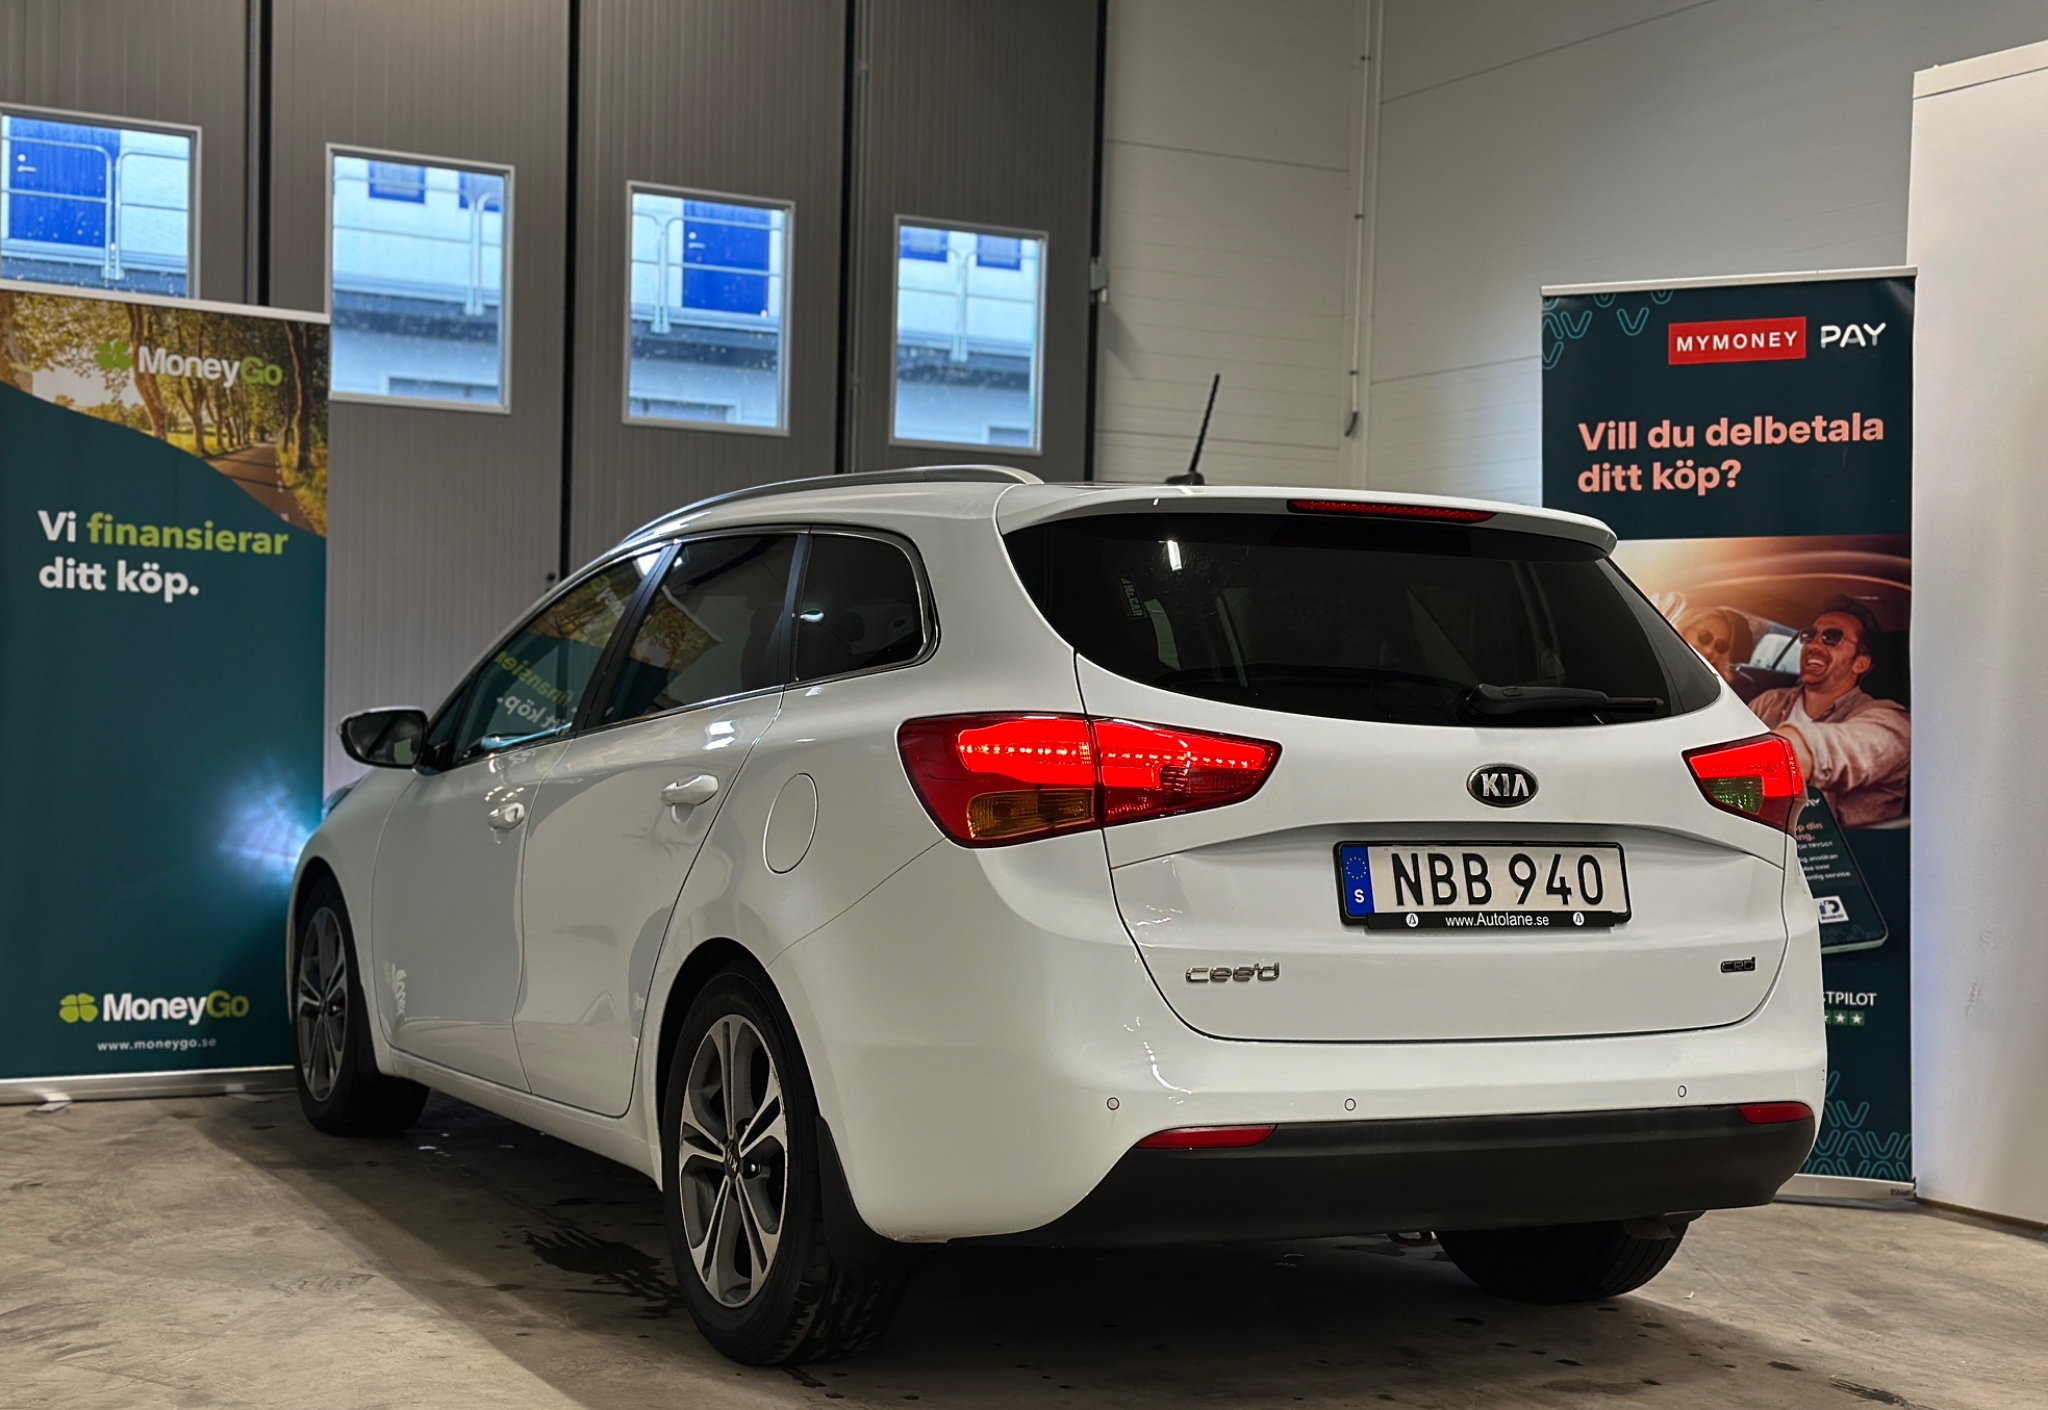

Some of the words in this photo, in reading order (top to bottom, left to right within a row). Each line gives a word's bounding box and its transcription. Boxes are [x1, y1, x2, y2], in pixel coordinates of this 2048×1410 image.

[1676, 330, 1798, 353] MYMONEY
[1820, 322, 1887, 349] PAY
[138, 345, 283, 389] MoneyGo
[1577, 421, 1638, 451] Vill
[1647, 419, 1695, 449] du
[1704, 412, 1885, 447] delbetala
[1577, 463, 1643, 493] ditt
[1652, 459, 1743, 497] köp?
[37, 510, 77, 543] Vi
[86, 512, 290, 556] finansierar
[38, 556, 107, 592] ditt
[116, 559, 200, 604] köp.
[1480, 773, 1530, 797] KIA
[1355, 888, 1365, 904] S
[1390, 852, 1493, 907] NBB
[1508, 853, 1605, 906] 940
[1444, 911, 1550, 928] www.Autolane.se
[102, 989, 250, 1026] MoneyGo
[1822, 990, 1878, 1007] TPILOT
[97, 1037, 218, 1052] www.moneygo.se
